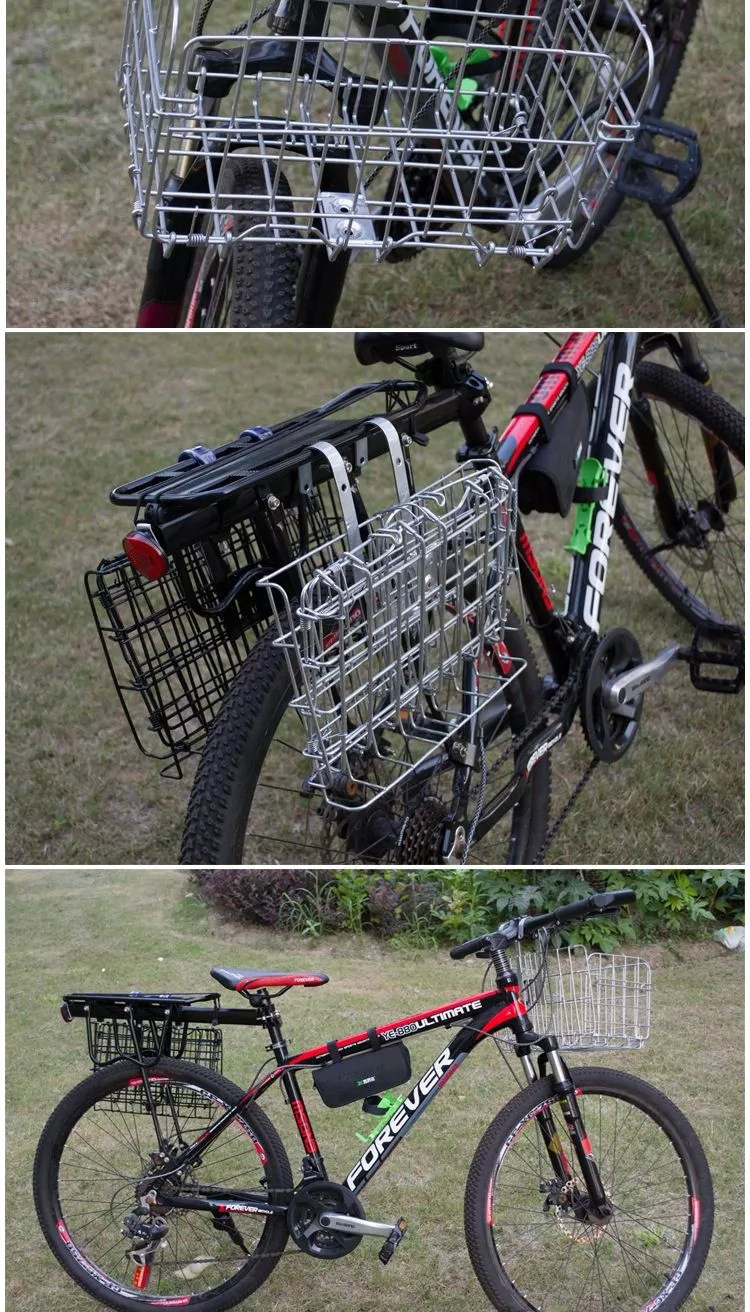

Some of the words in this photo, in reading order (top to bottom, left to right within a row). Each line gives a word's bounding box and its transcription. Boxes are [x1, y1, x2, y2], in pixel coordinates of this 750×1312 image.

[583, 362, 634, 634] FOREVER
[416, 999, 483, 1030] ULTIMATE
[346, 1047, 454, 1192] FOREVER
[226, 1204, 258, 1213] FOREVER
